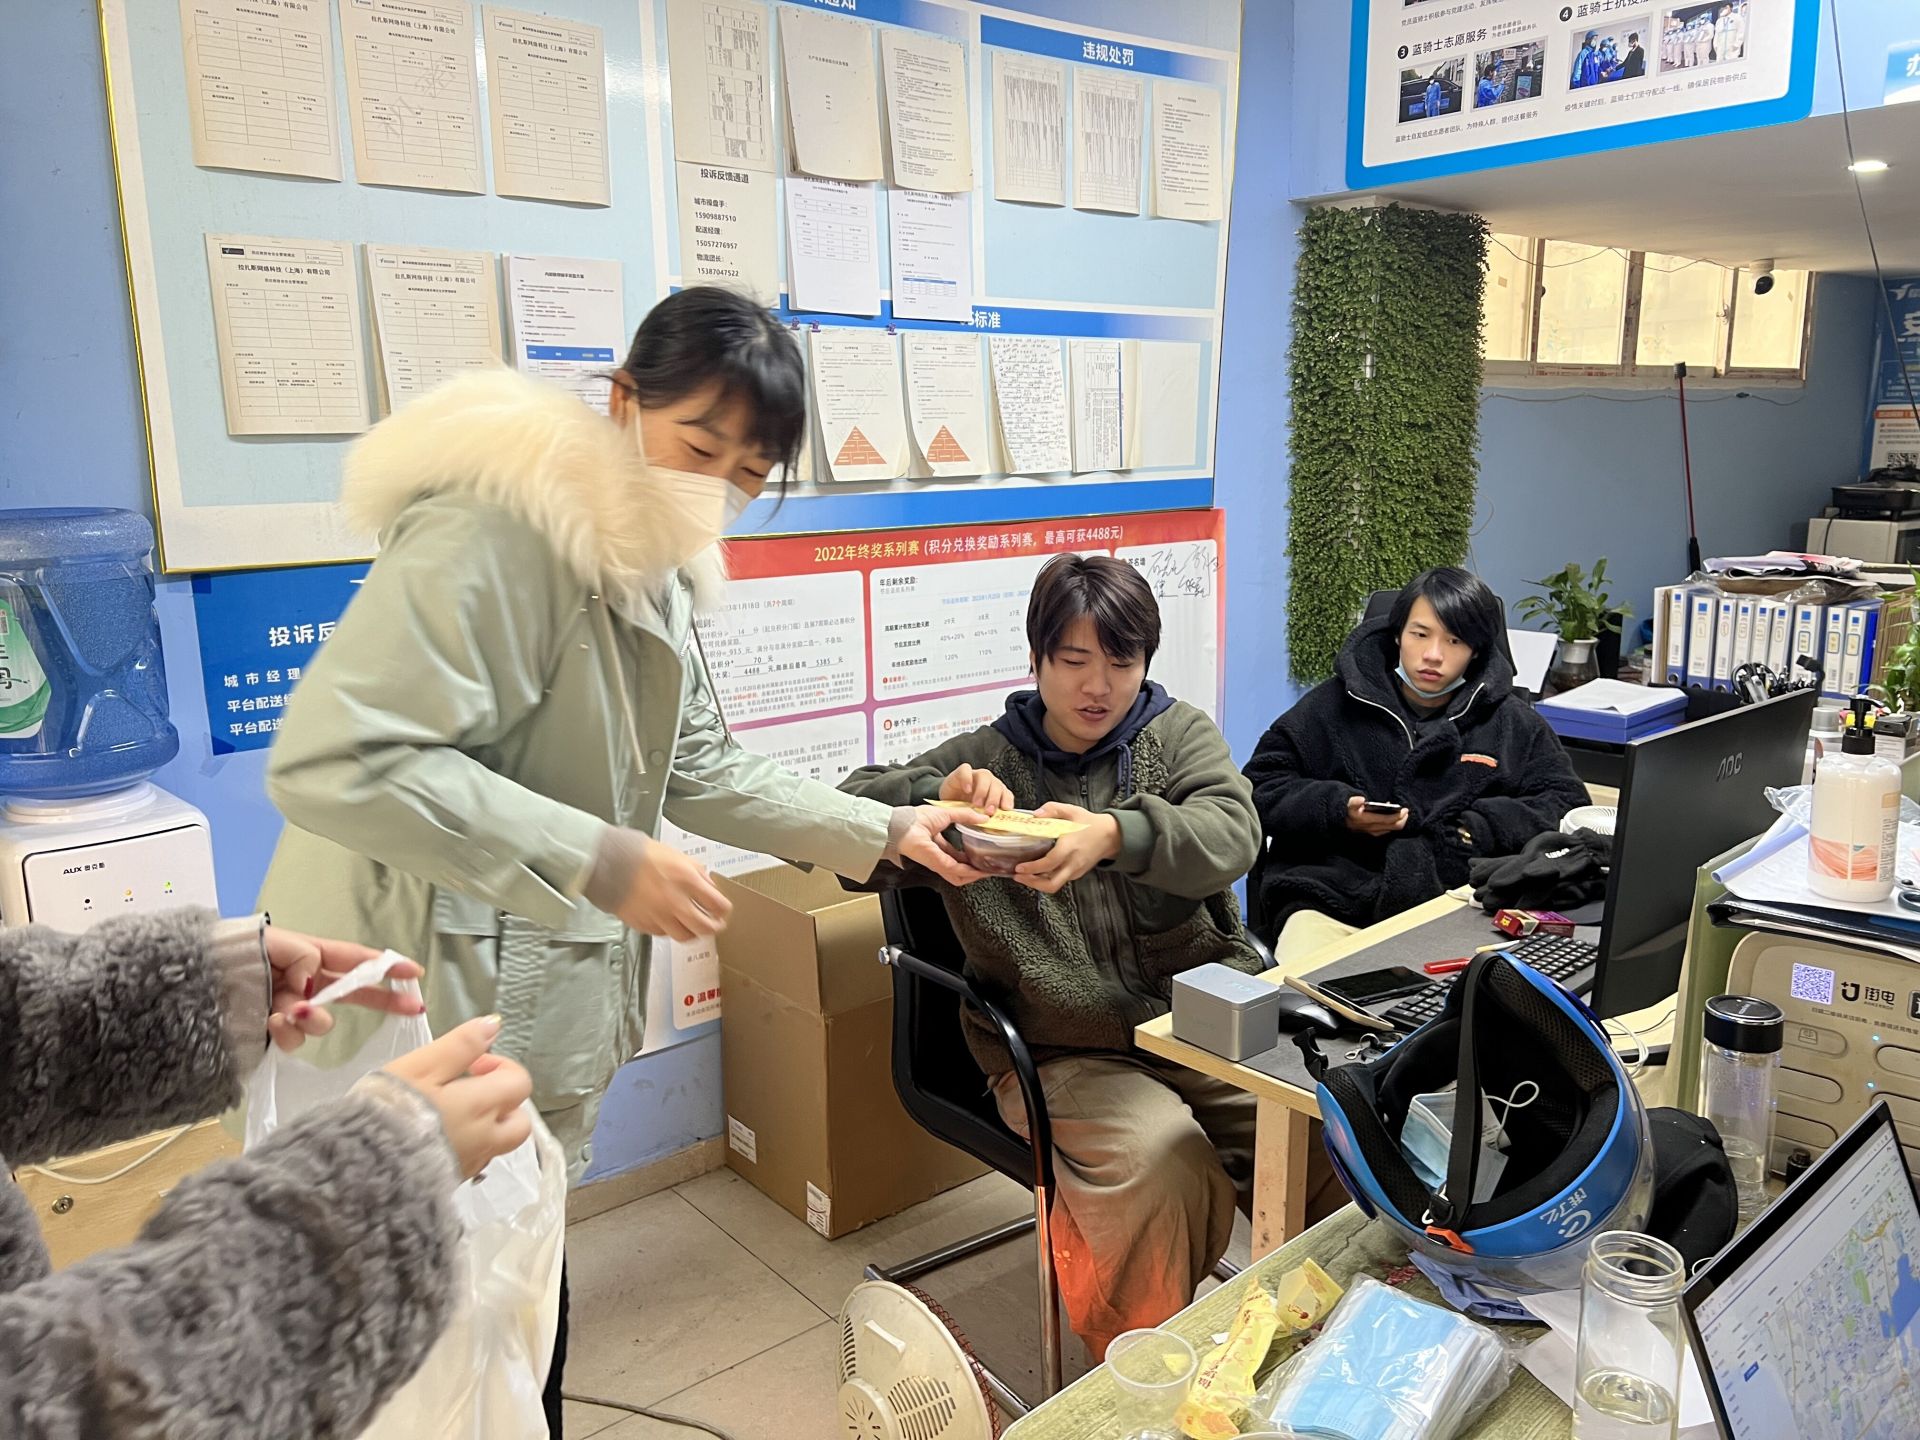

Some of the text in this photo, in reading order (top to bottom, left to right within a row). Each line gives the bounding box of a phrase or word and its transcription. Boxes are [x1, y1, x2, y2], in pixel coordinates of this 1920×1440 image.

[1412, 28, 1488, 56] 蓝骑士志愿服务
[1082, 41, 1134, 66] 违规处罚
[700, 168, 749, 184] 投诉反馈通道
[695, 211, 737, 222] 15909887510
[696, 239, 738, 249] 15057276957
[697, 267, 739, 277] 15387047522
[814, 540, 919, 563] 2022年终奖系列赛
[224, 667, 301, 688] 城市经理
[63, 866, 82, 875] AUX
[1865, 986, 1895, 1005] 街电
